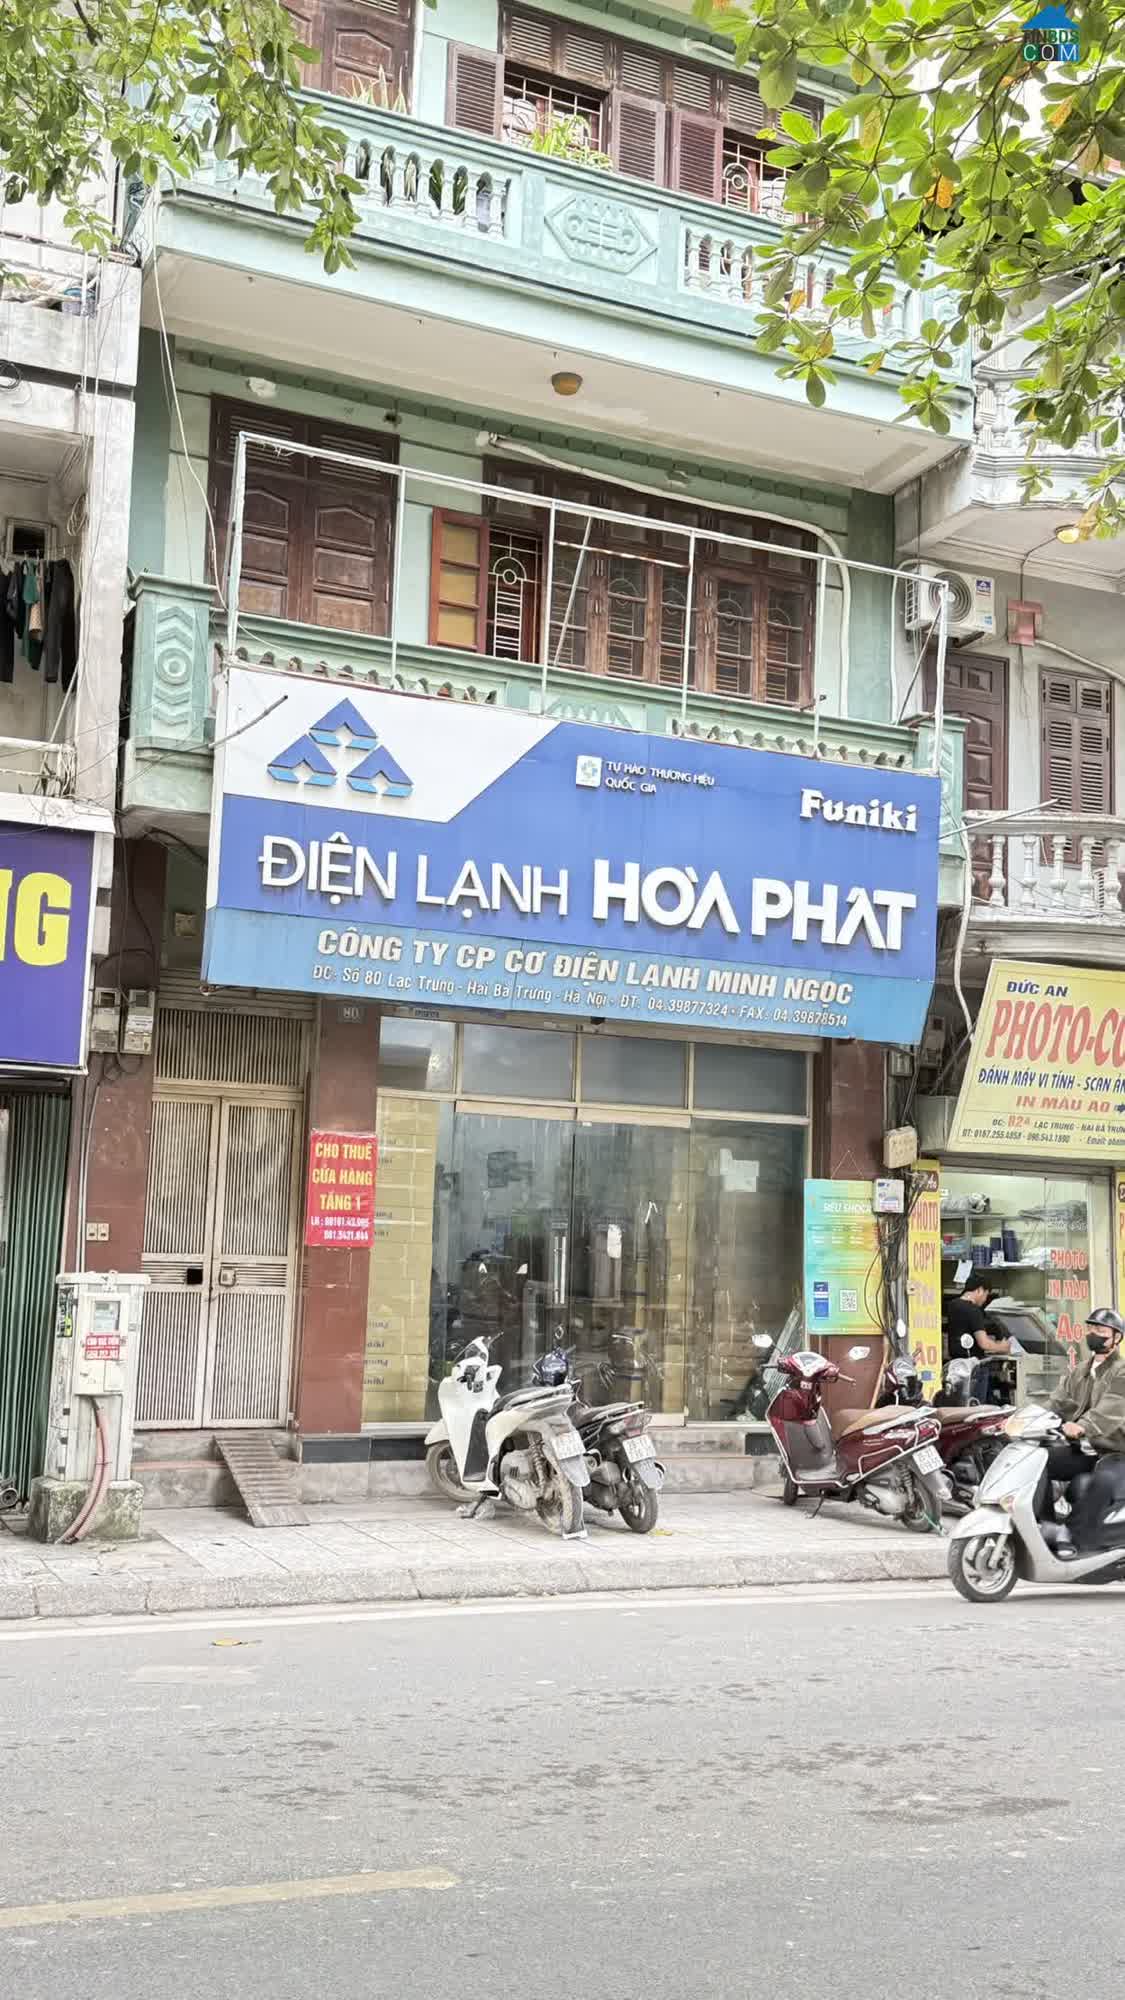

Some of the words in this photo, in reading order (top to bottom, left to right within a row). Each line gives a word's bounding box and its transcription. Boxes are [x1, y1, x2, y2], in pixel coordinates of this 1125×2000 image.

[604, 776, 637, 792] QUỐC
[640, 782, 657, 793] GIA
[799, 787, 918, 832] Funiki
[258, 831, 397, 905] ĐIỆN
[415, 853, 569, 919] LẠNH
[592, 858, 742, 934] HÒA
[317, 926, 403, 961] CÔNG
[413, 939, 449, 966] TY
[456, 944, 496, 970] CP
[504, 949, 547, 974] CƠ
[552, 951, 619, 987] ĐIỆN
[625, 961, 700, 992] LẠNH
[706, 969, 778, 998] MINH
[783, 976, 853, 1009] NGỌC
[342, 967, 360, 983] Số
[364, 970, 383, 985] 80
[1006, 979, 1040, 994] ĐỨC
[1044, 985, 1069, 997] AN
[978, 1064, 1010, 1086] ĐÁNH
[1011, 1067, 1036, 1088] MÁY
[1038, 1073, 1049, 1088] VI
[1051, 1070, 1075, 1090] TÍNH
[1083, 1076, 1112, 1093] SCAN
[1016, 1095, 1037, 1108] IN
[315, 1142, 339, 1159] CHO
[342, 1142, 372, 1160] THUÊ
[339, 1168, 373, 1186] HÀNG
[911, 1200, 938, 1232] PHOTO
[913, 1241, 936, 1273] COPY
[1050, 1248, 1089, 1271] PHOTO
